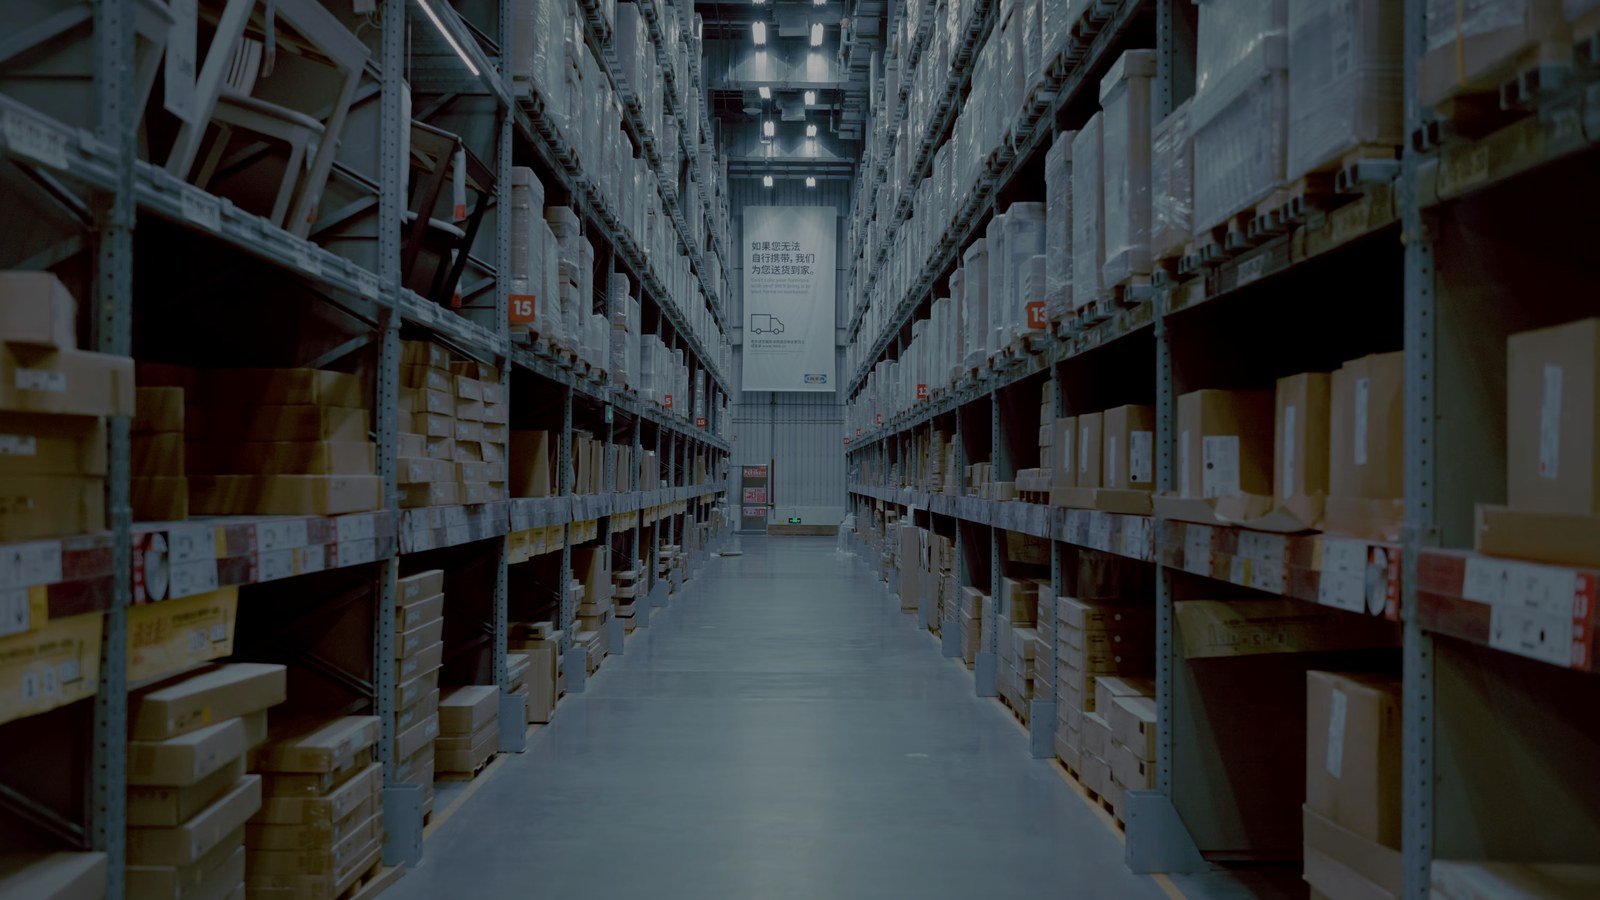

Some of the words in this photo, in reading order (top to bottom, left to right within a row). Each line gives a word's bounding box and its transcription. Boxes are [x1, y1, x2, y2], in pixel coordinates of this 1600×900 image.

[752, 242, 800, 251] 如果您无法
[752, 265, 814, 275] 为您送货到家。
[514, 300, 532, 316] 15
[1032, 306, 1047, 322] 13
